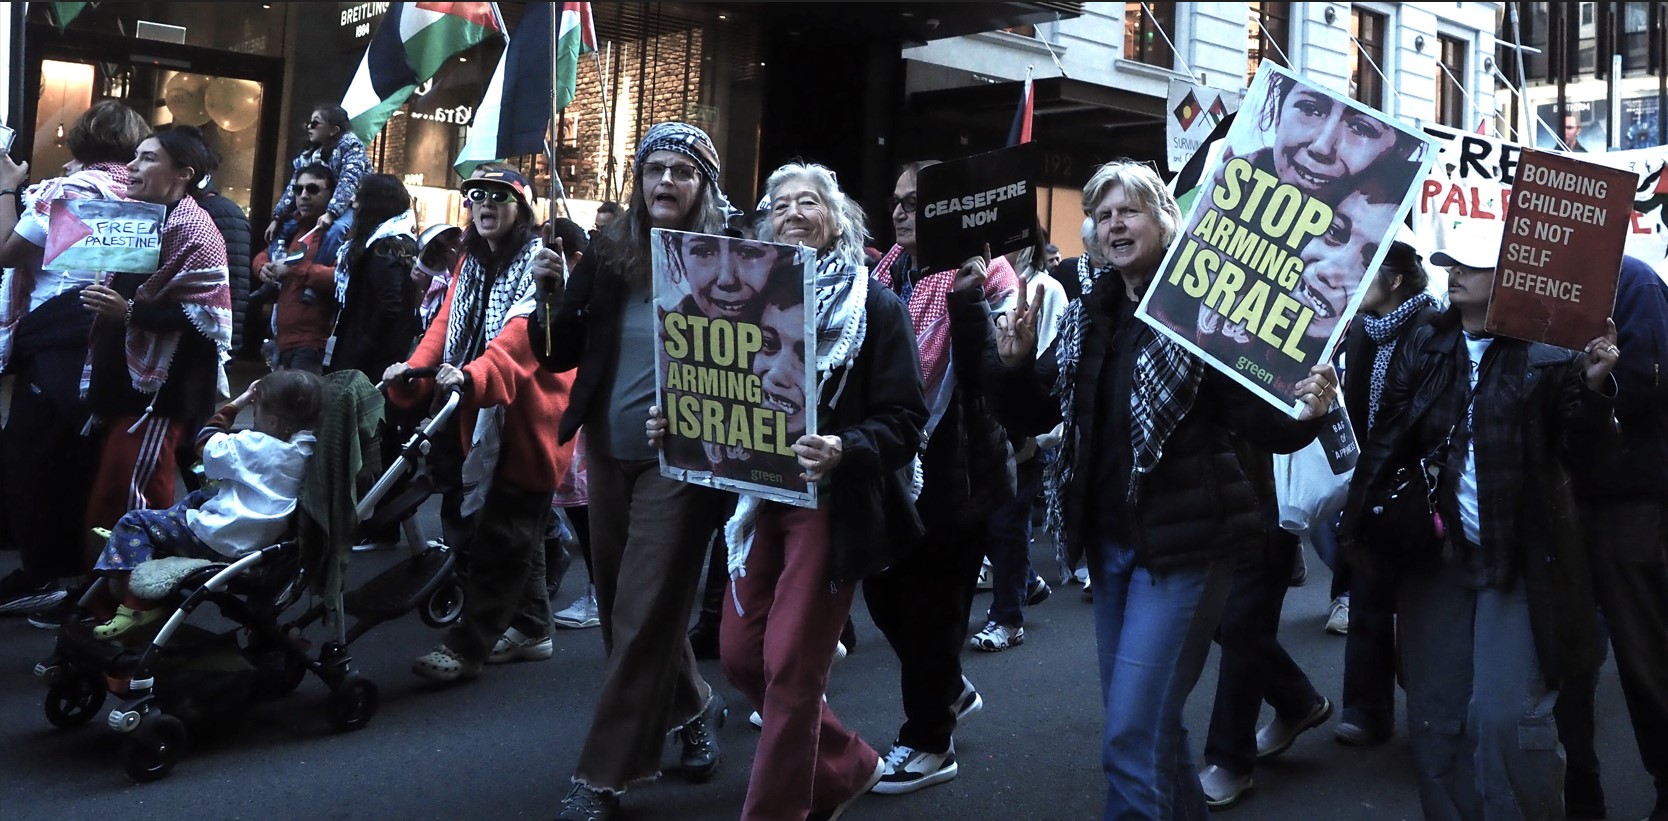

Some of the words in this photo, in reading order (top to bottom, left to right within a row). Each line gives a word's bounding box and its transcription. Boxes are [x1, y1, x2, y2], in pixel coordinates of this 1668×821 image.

[355, 23, 370, 38] 1884
[1044, 153, 1073, 176] 192
[1522, 163, 1608, 199] BOMBING
[924, 180, 1027, 218] CEASEFIRE
[1212, 157, 1334, 250] STOP
[1517, 190, 1607, 226] CHILDREN
[96, 221, 148, 234] FREE
[962, 207, 998, 229] NOW
[1512, 216, 1531, 236] IS
[1534, 221, 1574, 246] NOT
[85, 236, 157, 248] PALESTINE
[1193, 208, 1305, 292] ARMING
[1507, 242, 1552, 267] SELF
[1168, 239, 1315, 363] ISRAEL
[1502, 269, 1582, 303] DEFENCE
[663, 312, 763, 369] STOP
[667, 362, 763, 404] ARMING
[1235, 356, 1274, 384] green
[666, 392, 796, 457] ISRAEL
[751, 468, 783, 483] green
